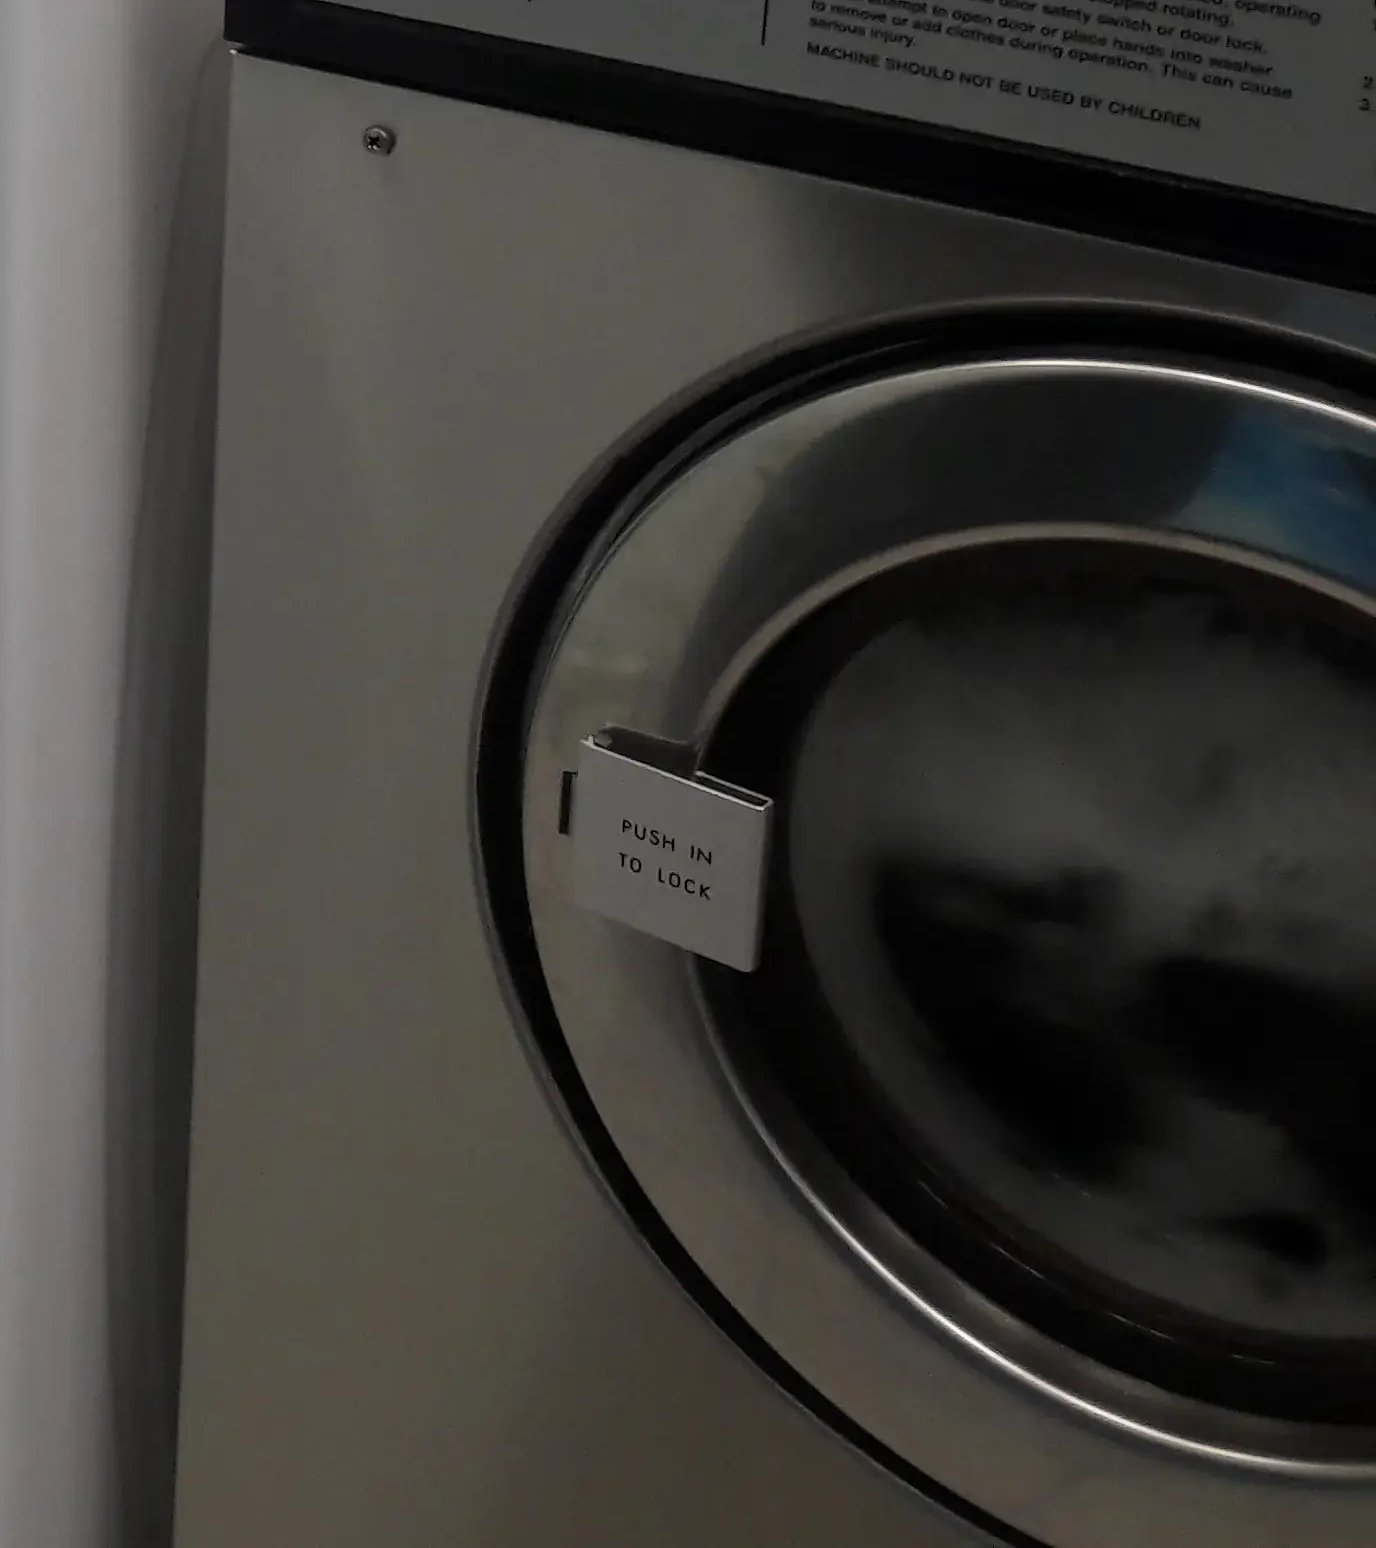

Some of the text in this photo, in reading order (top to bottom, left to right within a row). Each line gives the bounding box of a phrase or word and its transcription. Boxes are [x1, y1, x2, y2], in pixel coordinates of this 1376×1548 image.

[807, 41, 1201, 130] MACHINE SHOULD NOT BE USED BY CHILDREN
[621, 818, 714, 866] PUSH IN
[618, 851, 712, 901] TO LOCK
